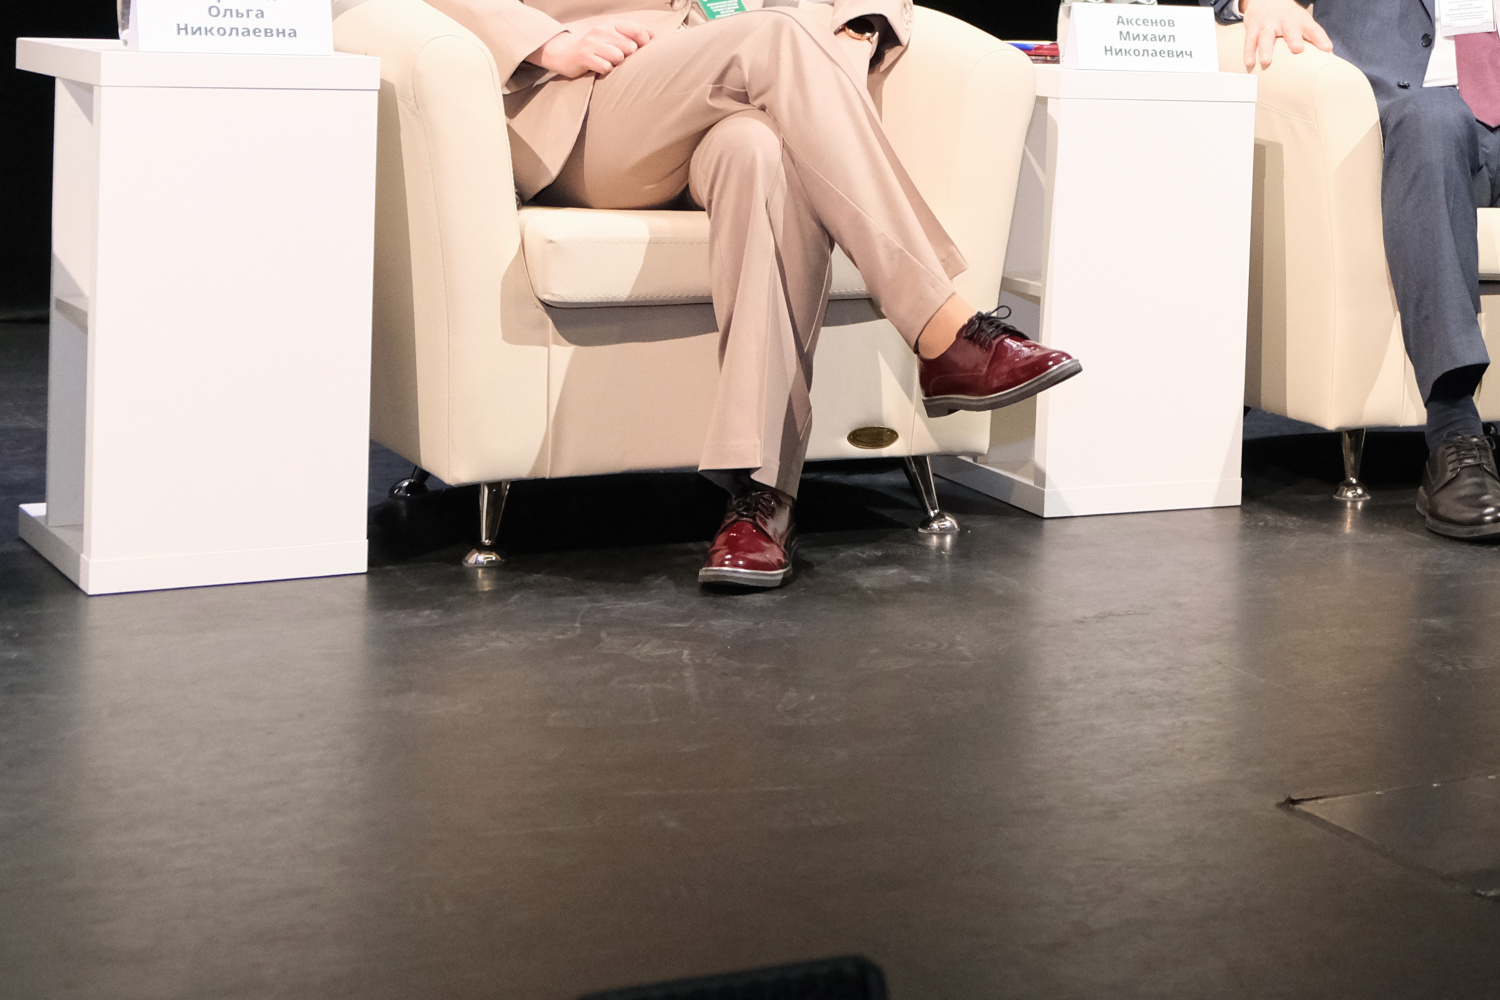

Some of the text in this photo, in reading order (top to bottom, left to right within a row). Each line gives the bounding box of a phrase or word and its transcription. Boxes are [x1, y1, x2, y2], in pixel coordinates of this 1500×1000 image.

[207, 5, 265, 19] Ольга
[1116, 15, 1176, 28] Аксенов
[176, 22, 298, 38] Николаевна
[1118, 30, 1177, 43] Михаил
[1103, 45, 1193, 59] Николаевич
